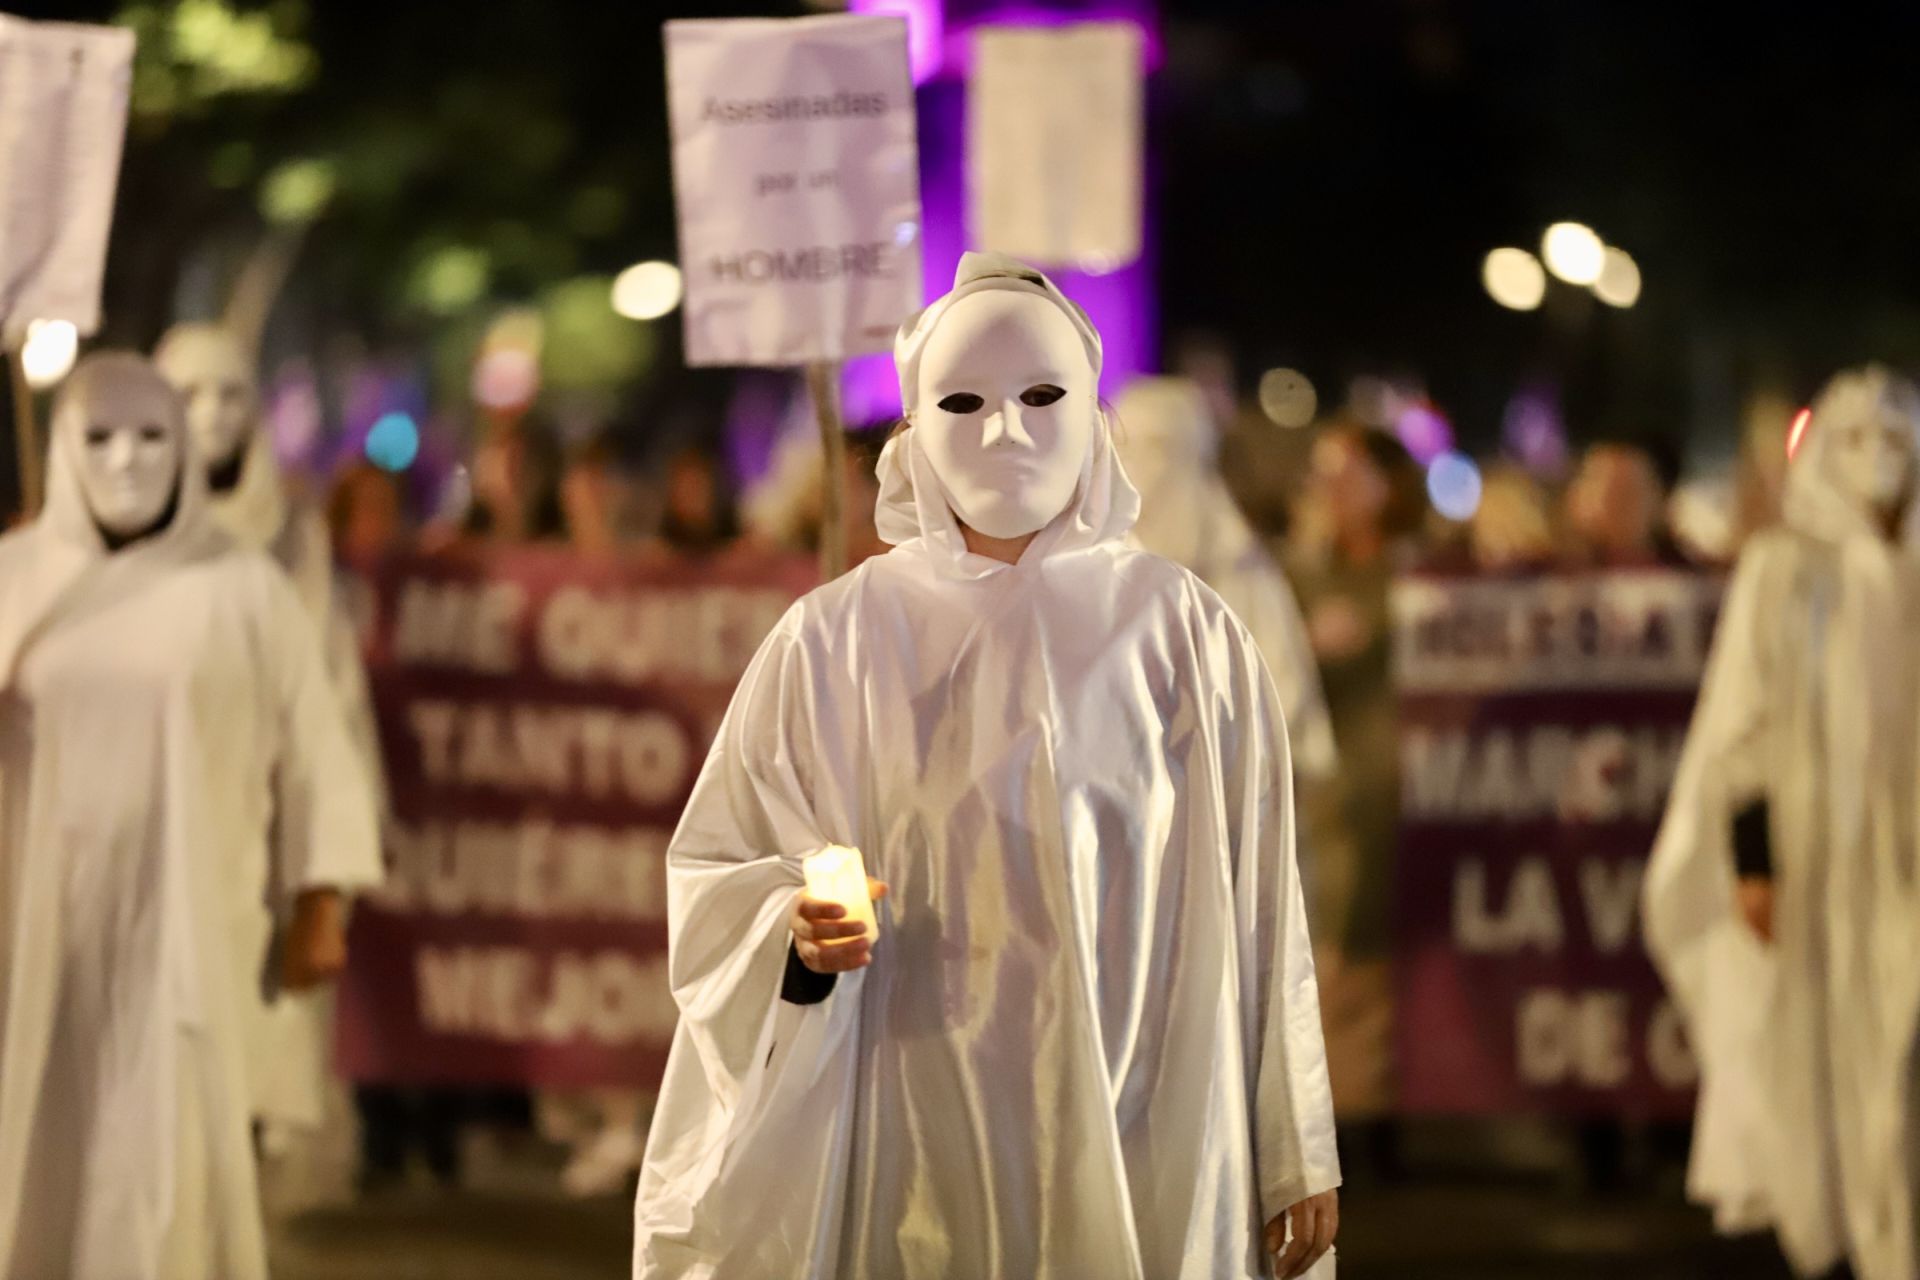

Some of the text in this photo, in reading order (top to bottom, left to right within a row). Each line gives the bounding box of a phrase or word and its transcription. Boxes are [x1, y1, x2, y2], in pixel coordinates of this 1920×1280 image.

[702, 91, 887, 123] Asesinadas
[709, 242, 895, 283] HOMBRE
[411, 702, 690, 798] TANTO
[1455, 855, 1562, 955] LA
[1513, 987, 1632, 1086] DE
